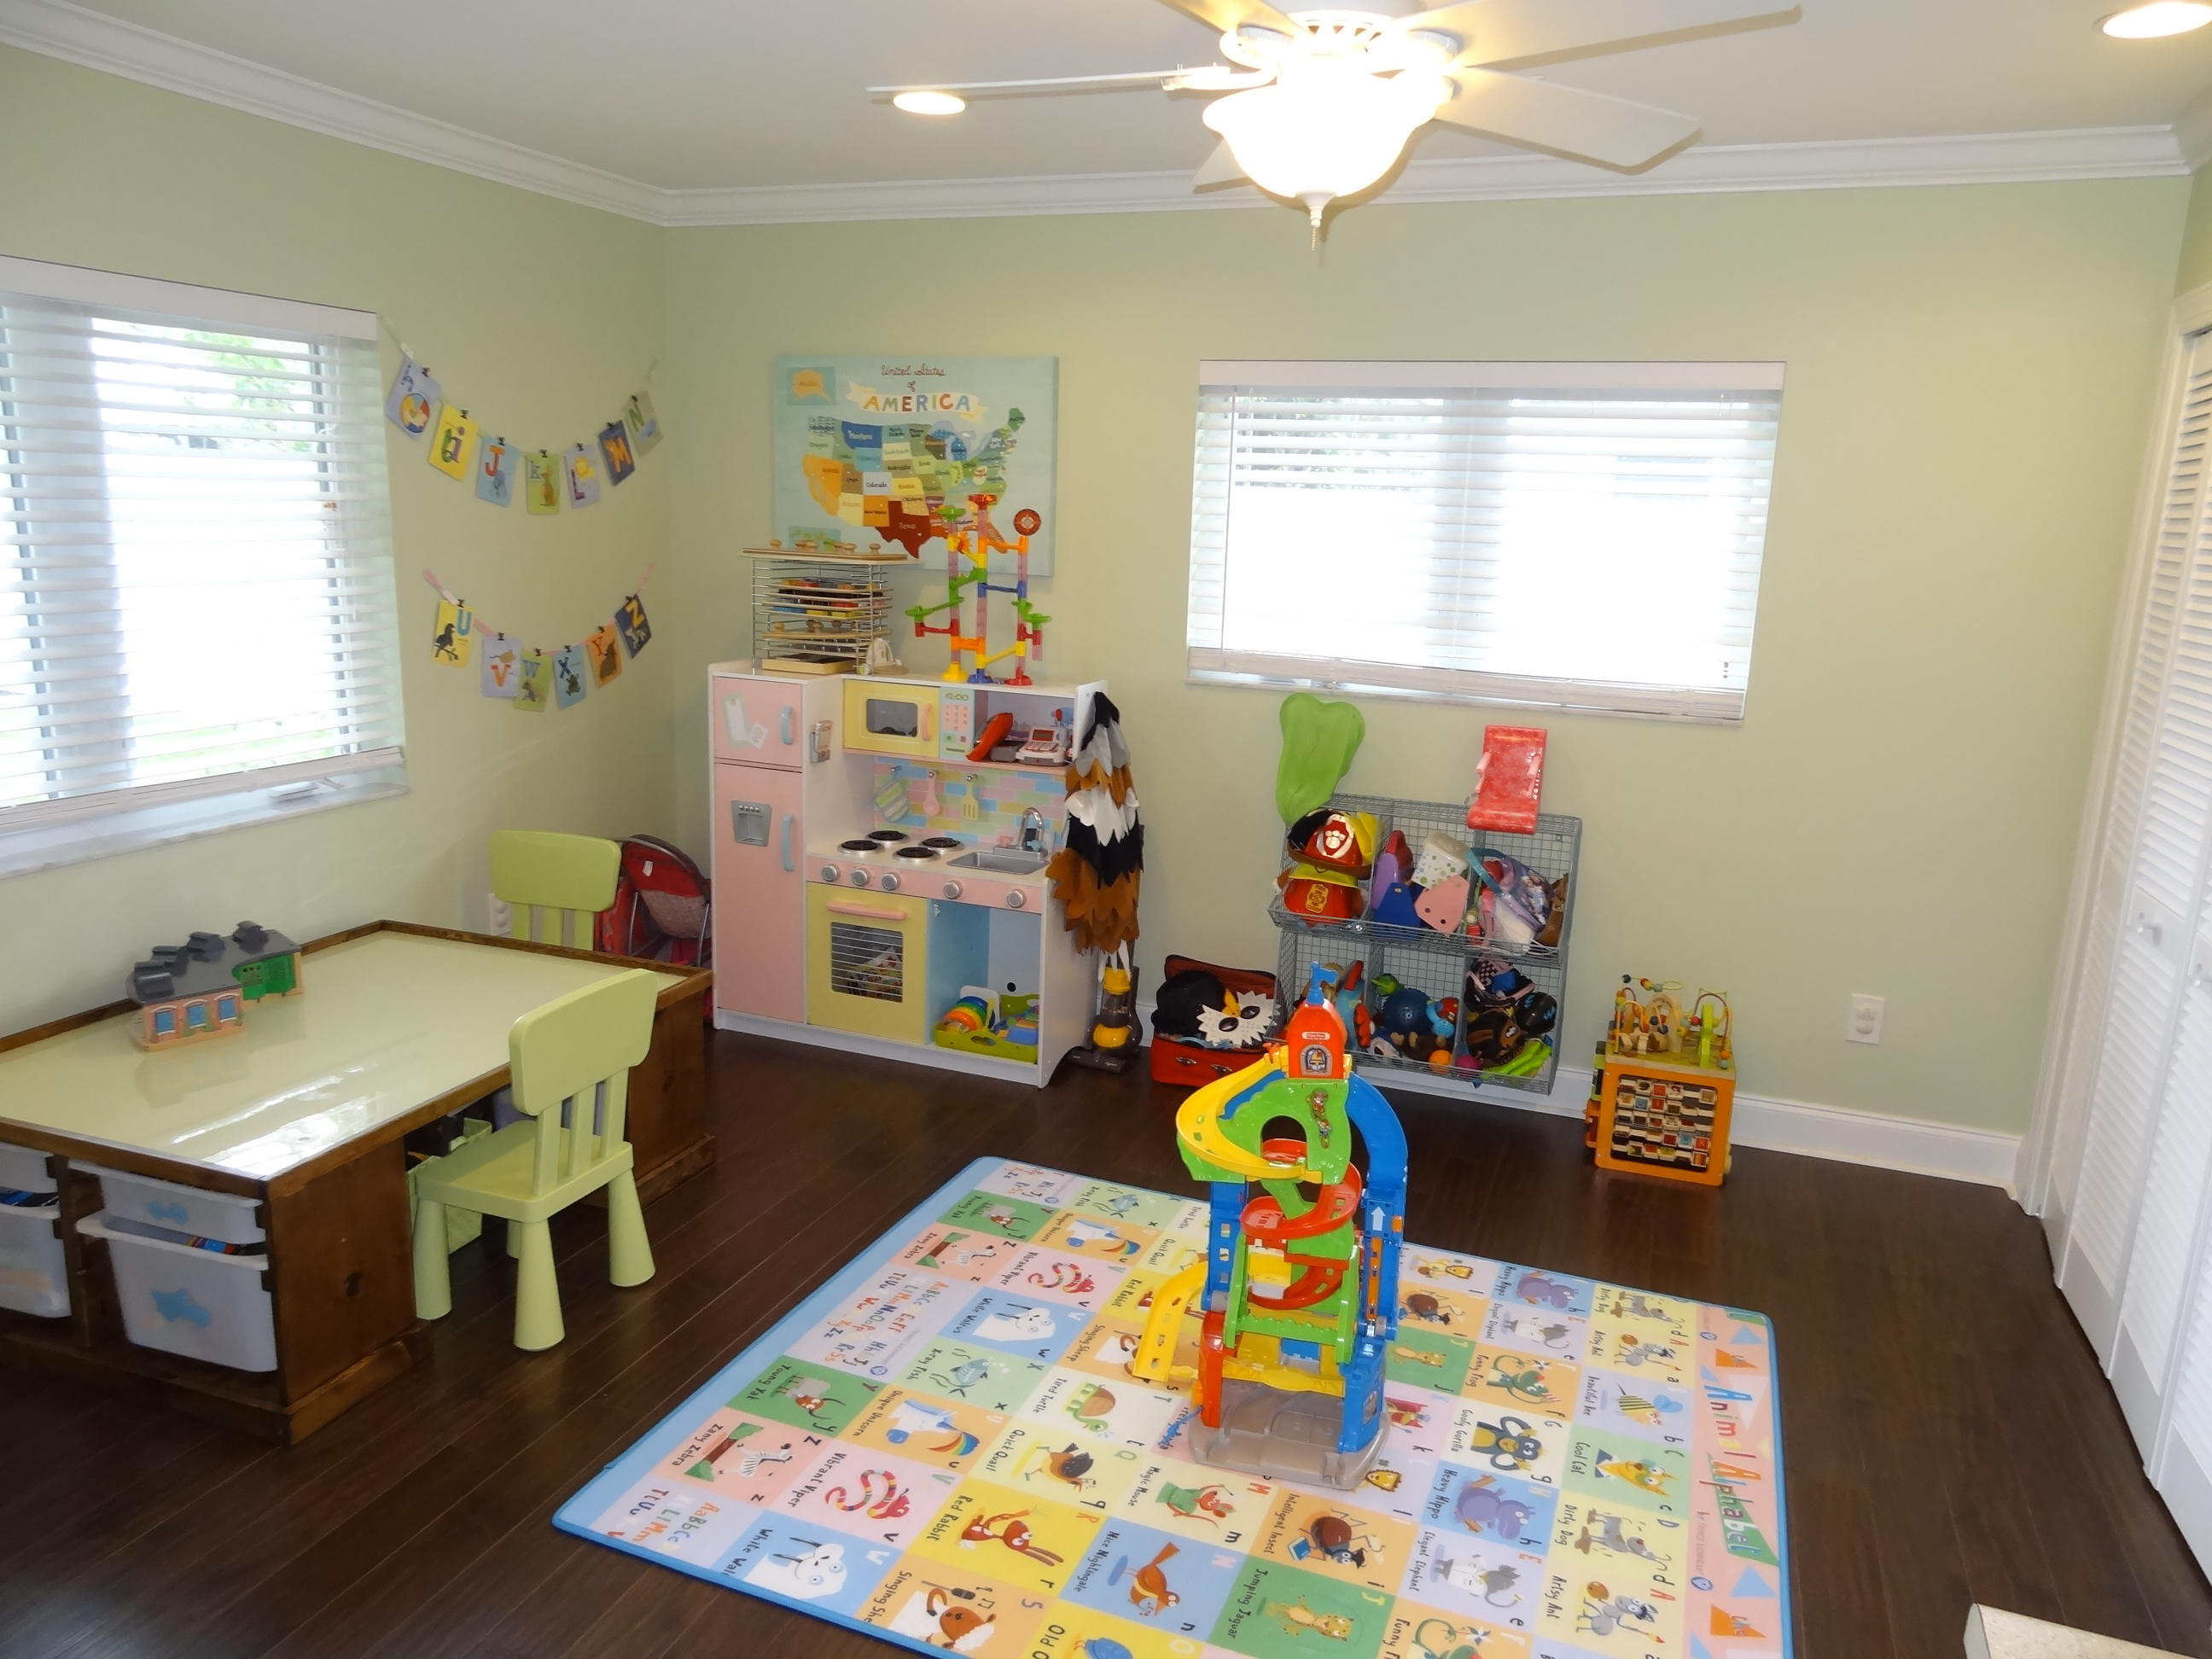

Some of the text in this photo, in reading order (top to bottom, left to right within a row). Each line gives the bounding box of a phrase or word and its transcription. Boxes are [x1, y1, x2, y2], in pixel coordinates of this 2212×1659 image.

[882, 364, 911, 376] United
[862, 393, 970, 412] AMERICA
[485, 444, 506, 477] J
[456, 608, 472, 637] U
[491, 663, 512, 688] V
[952, 1297, 992, 1333] White Walrus
[1066, 1324, 1105, 1362] Singing Sheep
[746, 1364, 791, 1400] Young Yak
[905, 1365, 927, 1380] Fish
[876, 1389, 903, 1410] Unique
[1032, 1377, 1067, 1413] Tired Turtle
[853, 1412, 882, 1436] Unicorn
[1450, 1408, 1473, 1452] Goofy Gorilla
[671, 1423, 723, 1466] Zany Zebra
[985, 1429, 1025, 1471] Quick Quail
[1569, 1441, 1591, 1475] Cool Cat
[788, 1452, 846, 1507] Vibrant Viper
[1127, 1465, 1161, 1506] Magic Mouse
[1247, 1482, 1270, 1494] M
[1702, 1384, 1765, 1557] Animal Alphabet
[1426, 1469, 1458, 1519] Heavy Hippo
[926, 1494, 973, 1540] Red Rabbit
[1262, 1493, 1300, 1554] Intelligent Insect
[1553, 1504, 1577, 1545] Dirty Dog
[742, 1528, 772, 1553] White
[1224, 1530, 1242, 1543] m
[1074, 1530, 1120, 1592] Nice Nightingale
[1408, 1530, 1435, 1592] Elegant Elephant
[872, 1570, 911, 1604] Singing
[1039, 1578, 1054, 1589] r
[1544, 1575, 1567, 1619] Artsy Ant
[1227, 1569, 1268, 1639] Jumping Jaguar
[1039, 1624, 1065, 1647] Old
[1179, 1621, 1196, 1633] n
[1381, 1615, 1410, 1646] Funny
